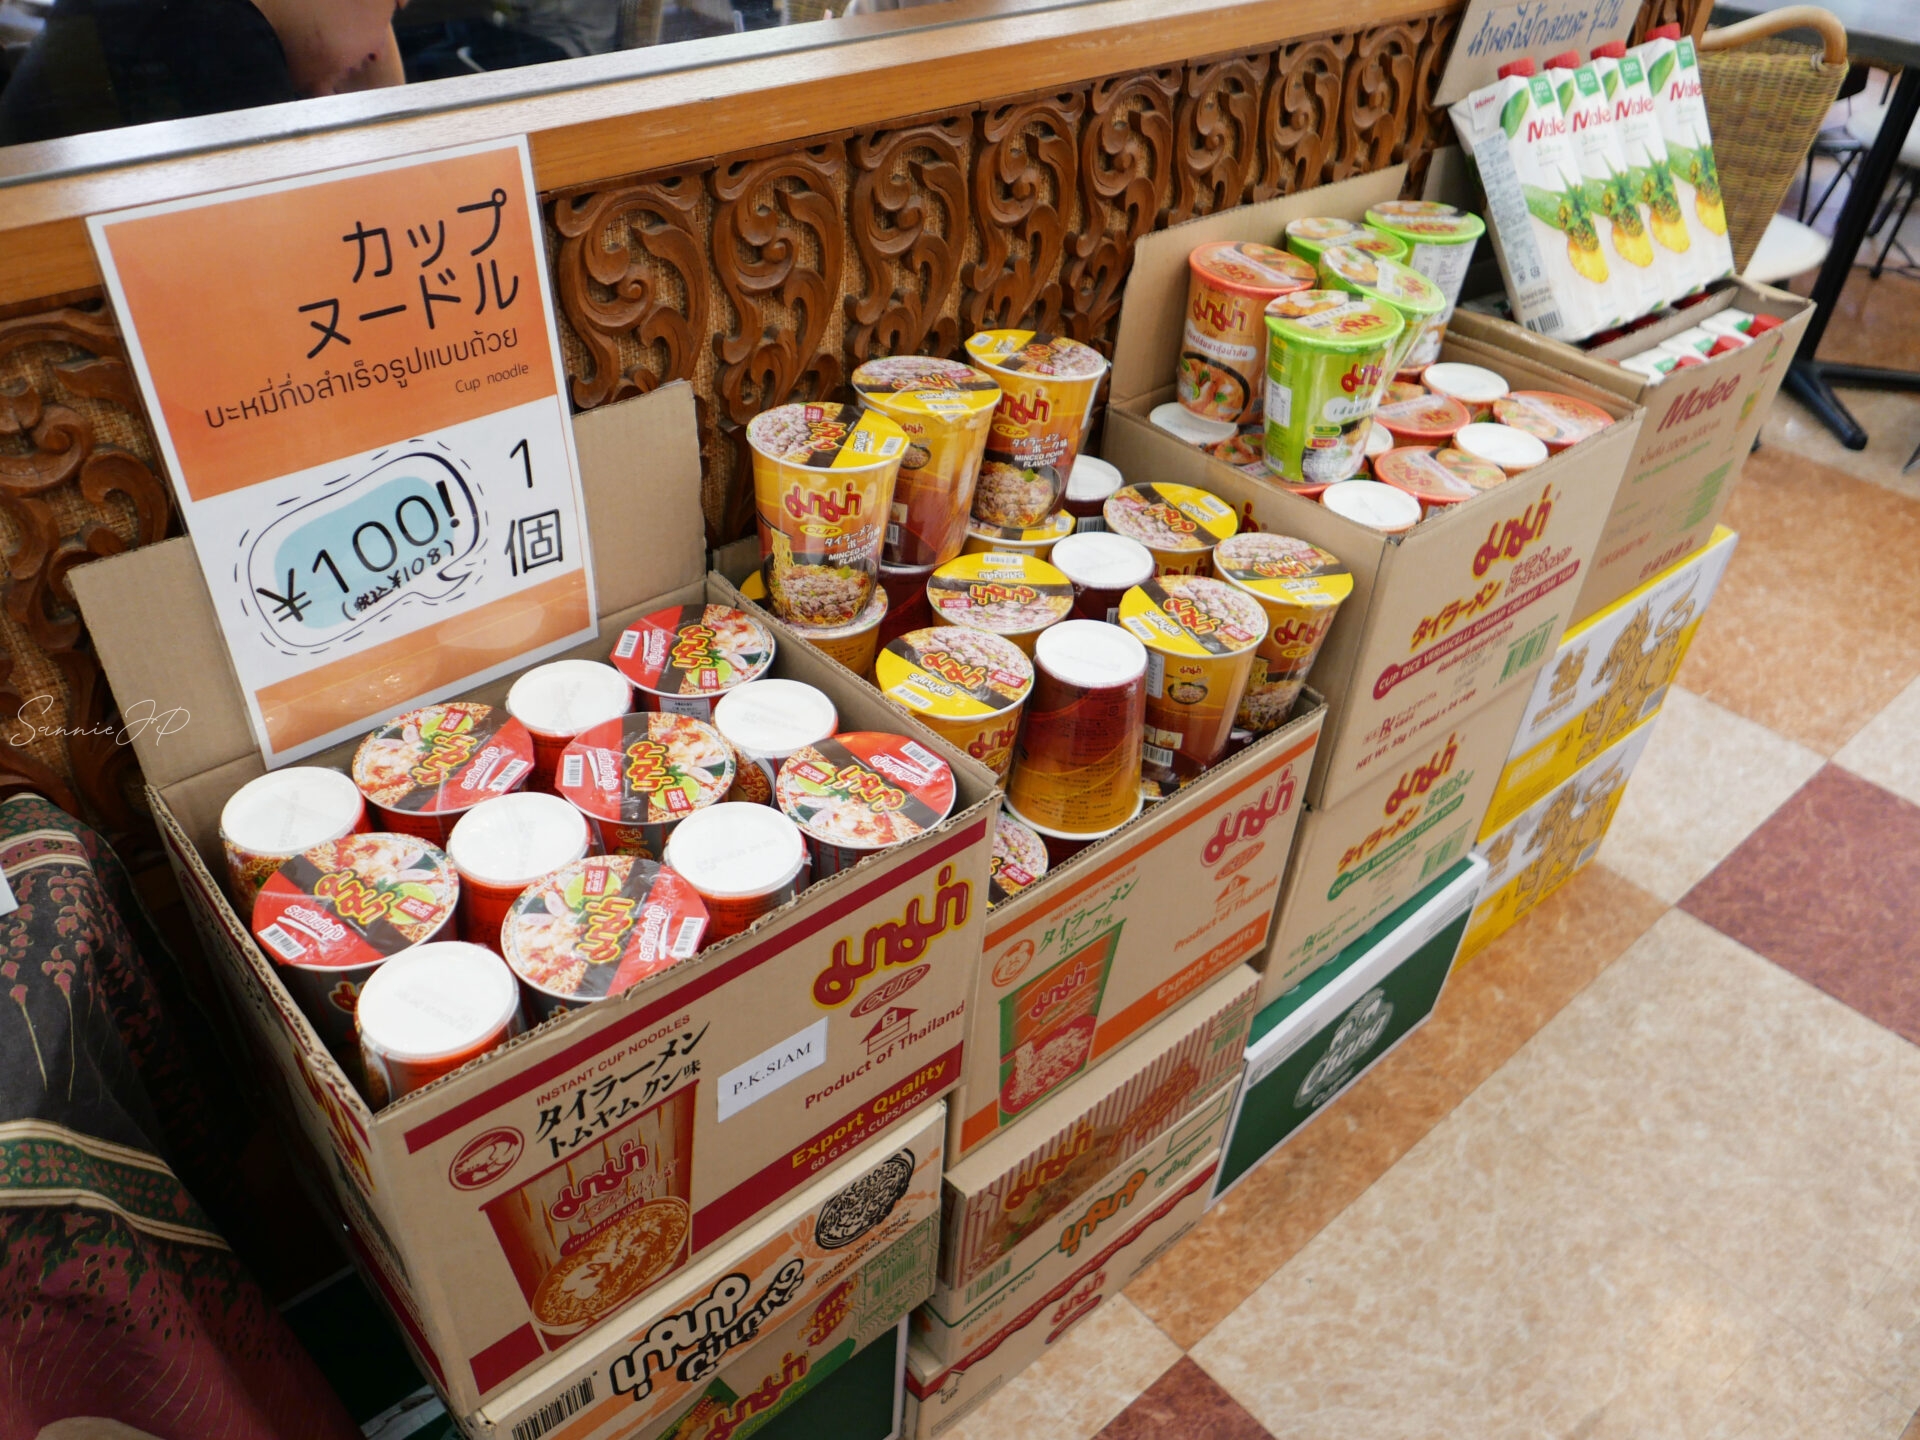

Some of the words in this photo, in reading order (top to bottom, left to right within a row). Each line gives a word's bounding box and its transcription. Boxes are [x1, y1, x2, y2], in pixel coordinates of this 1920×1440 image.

[343, 187, 507, 283] カップ
[298, 259, 519, 359] ヌードル
[1193, 293, 1247, 331] มาม่า
[205, 326, 519, 429] บะหมี่กึ่งสำเร็จรูปแบบถ้วย
[455, 374, 481, 396] Cup
[486, 362, 530, 388] noodle
[1657, 374, 1741, 433] Malee
[996, 426, 1026, 436] CUP
[1012, 434, 1058, 446] タイラーメン
[1015, 453, 1044, 461] MINCED
[1045, 450, 1064, 459] PORK
[1023, 457, 1056, 467] FLAVOUR
[785, 482, 861, 522] มาม่า
[256, 480, 460, 623] ¥100!
[805, 526, 838, 536] CUP
[825, 523, 872, 547] タイラーメン
[829, 548, 860, 560] MINCED
[838, 549, 872, 565] FLAVOUR
[1472, 483, 1552, 579] มาม่า
[970, 584, 1036, 605] มาม่า
[1164, 598, 1221, 634] มาม่า
[1411, 581, 1502, 652] タイラーメン
[672, 625, 715, 668] มาม่า
[921, 652, 986, 690] มาม่า
[1378, 670, 1400, 692] CUP
[1401, 658, 1421, 677] RICE
[1424, 631, 1472, 665] VERMICELLI
[1472, 608, 1506, 633] SHRIMP
[411, 734, 477, 784] มาม่า
[626, 741, 676, 791] มาม่า
[1356, 755, 1373, 771] NET
[1384, 731, 1458, 817] มาม่า
[832, 765, 905, 812] มาม่า
[1202, 767, 1298, 868] มาม่า
[1337, 804, 1421, 874] タイラーメン
[284, 905, 346, 941] รสต้มยำกุ้ง
[314, 871, 395, 925] มาม่า
[1038, 876, 1140, 956] タイラーメン
[576, 897, 635, 964] มาม่า
[812, 864, 970, 1010] มาม่า
[856, 966, 926, 1014] CUP
[1029, 962, 1088, 1020] มาม่า
[1157, 961, 1205, 1000] Export
[536, 1068, 593, 1106] INSTANT
[598, 1051, 625, 1072] CUP
[628, 1014, 690, 1053] NOODLES
[536, 1021, 710, 1143] タイラーメン
[732, 1041, 812, 1095] P.K.SIAM
[804, 1059, 871, 1110] Product
[877, 1047, 895, 1066] of
[899, 1000, 965, 1050] Thailand
[550, 1059, 701, 1158] トムヤムクン味
[792, 1111, 864, 1169] Export
[873, 1061, 946, 1115] Quality
[811, 1156, 826, 1170] 60
[851, 1129, 866, 1144] 24
[868, 1087, 929, 1132] CUPS/BOX
[551, 1139, 648, 1222] มาม่า
[1004, 1118, 1096, 1212] มาม่า
[570, 1225, 600, 1249] SHRIMP
[603, 1213, 621, 1229] TOM
[1058, 1167, 1149, 1257] มาม่า
[676, 1259, 804, 1383] ต้มยำกุ้ง
[1049, 1269, 1107, 1326] มาม่า
[609, 1273, 750, 1401] มาม่า
